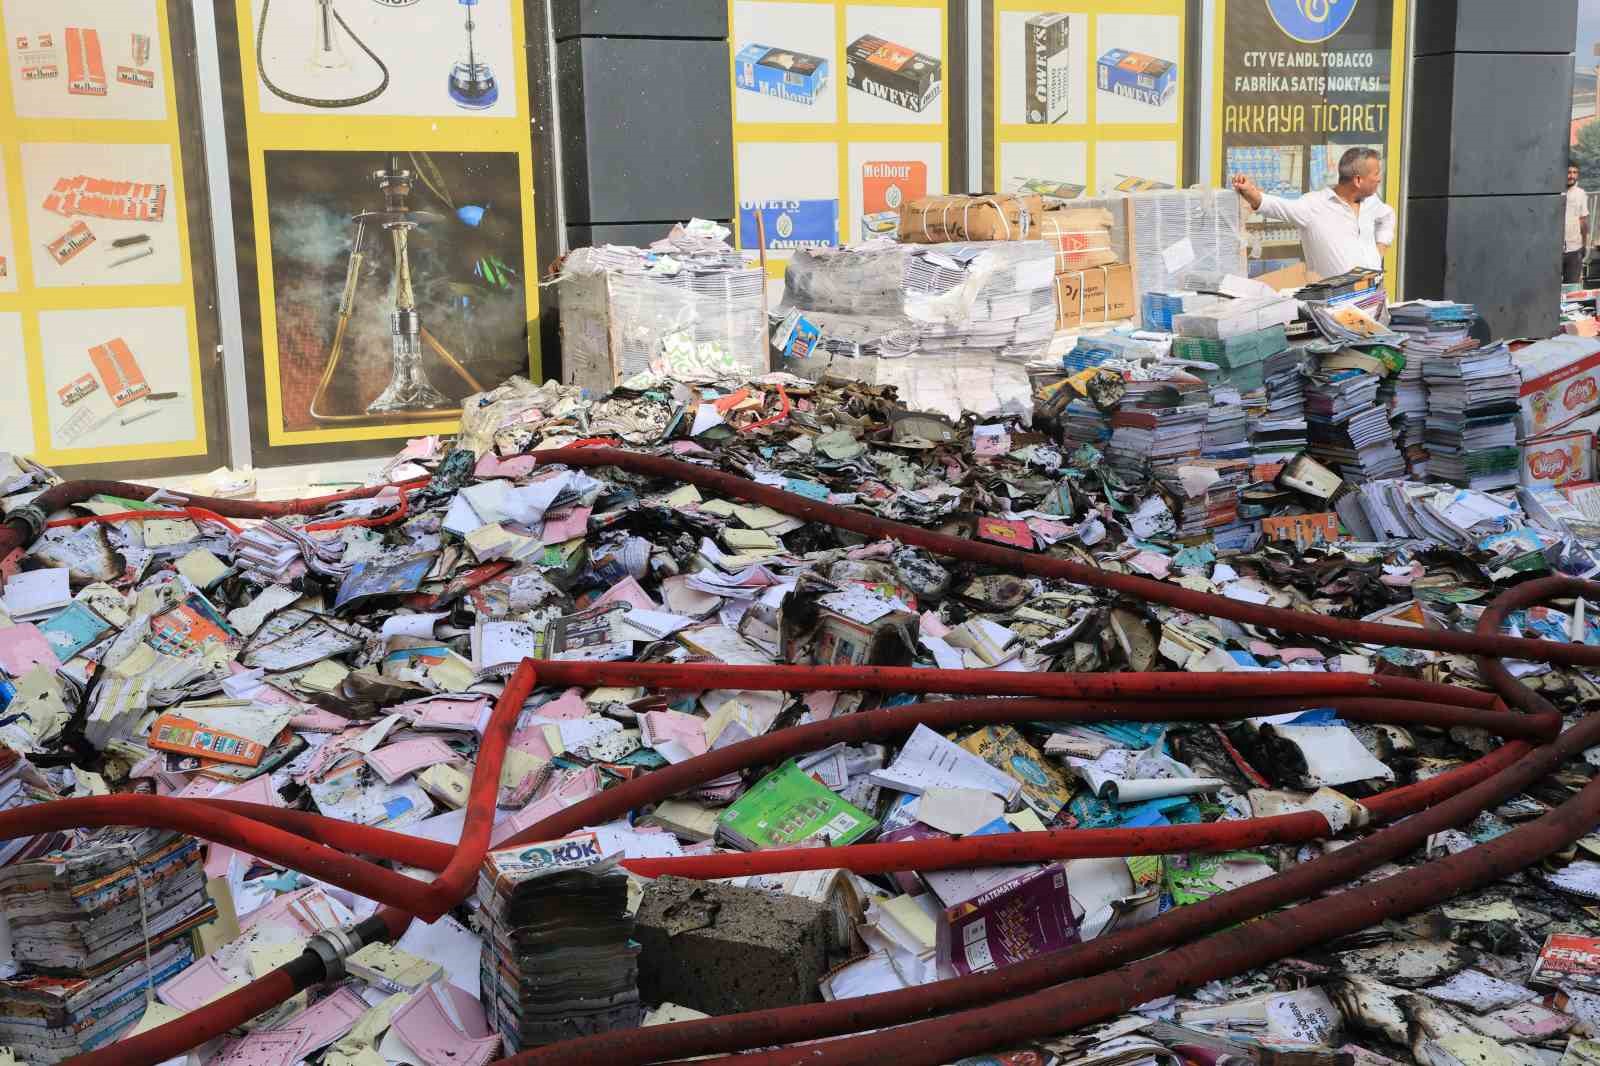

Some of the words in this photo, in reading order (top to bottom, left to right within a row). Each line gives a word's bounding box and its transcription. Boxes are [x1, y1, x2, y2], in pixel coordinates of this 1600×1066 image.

[1243, 52, 1268, 67] CTY
[1267, 52, 1286, 67] VE
[1320, 52, 1374, 67] TOBACCO
[861, 78, 920, 113] OWEYS
[1113, 82, 1161, 108] OWEYS
[1234, 72, 1291, 92] FABRİKA
[1290, 75, 1327, 95] SATIŞ
[1327, 76, 1380, 92] NOKTASI
[1224, 104, 1305, 133] AKKAYA
[1311, 99, 1388, 133] TİCARET
[552, 840, 597, 862] KÖK
